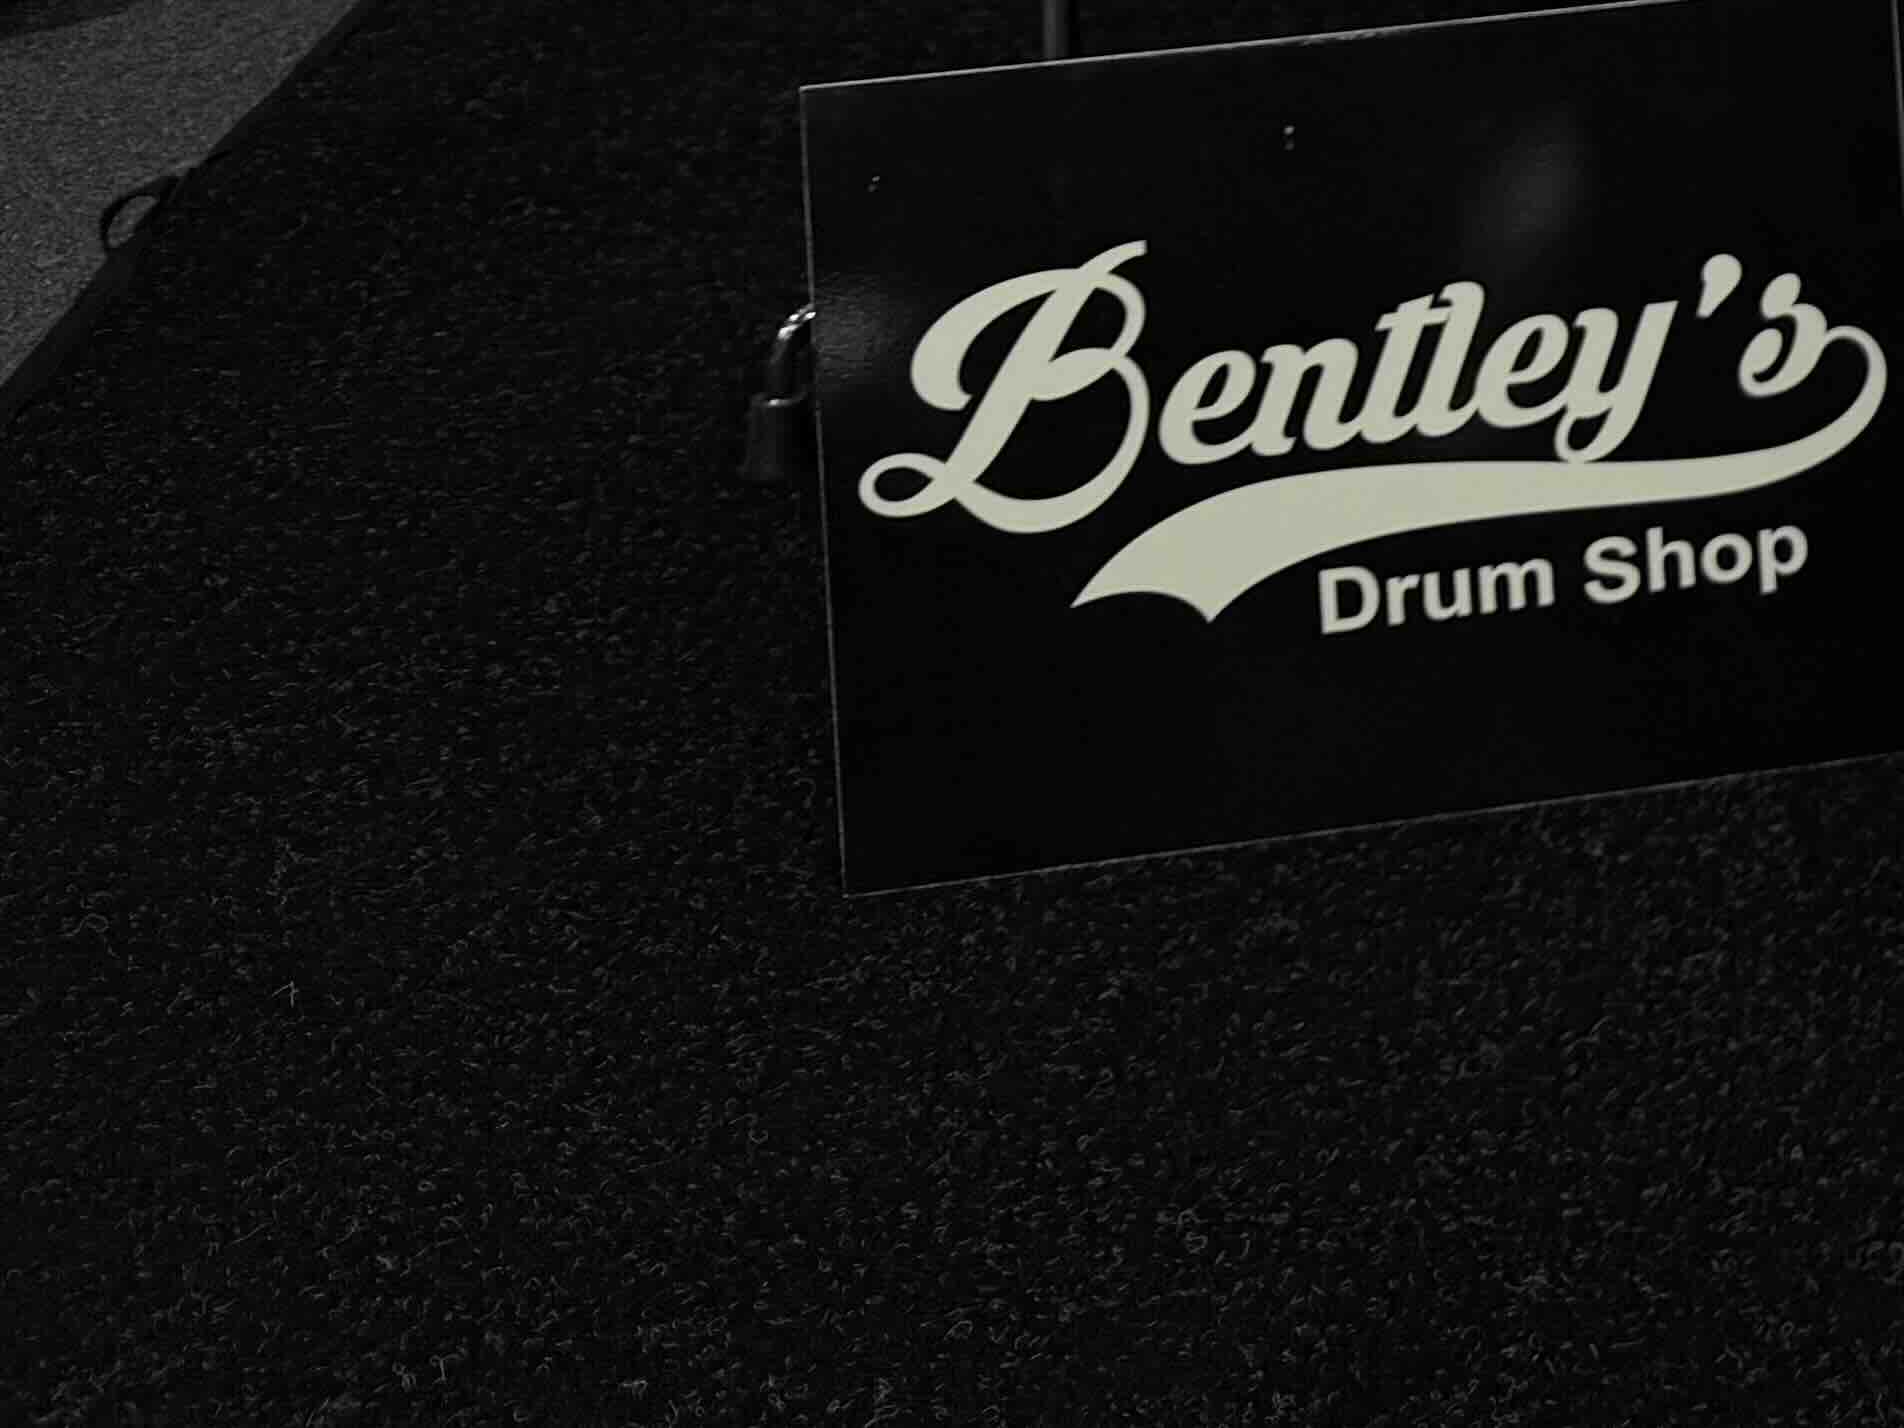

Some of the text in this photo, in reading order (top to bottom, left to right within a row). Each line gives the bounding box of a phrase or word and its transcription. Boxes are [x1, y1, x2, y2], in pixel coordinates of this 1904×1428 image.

[856, 238, 1866, 535] Bentley's
[1314, 518, 1811, 637] Drum Shop
